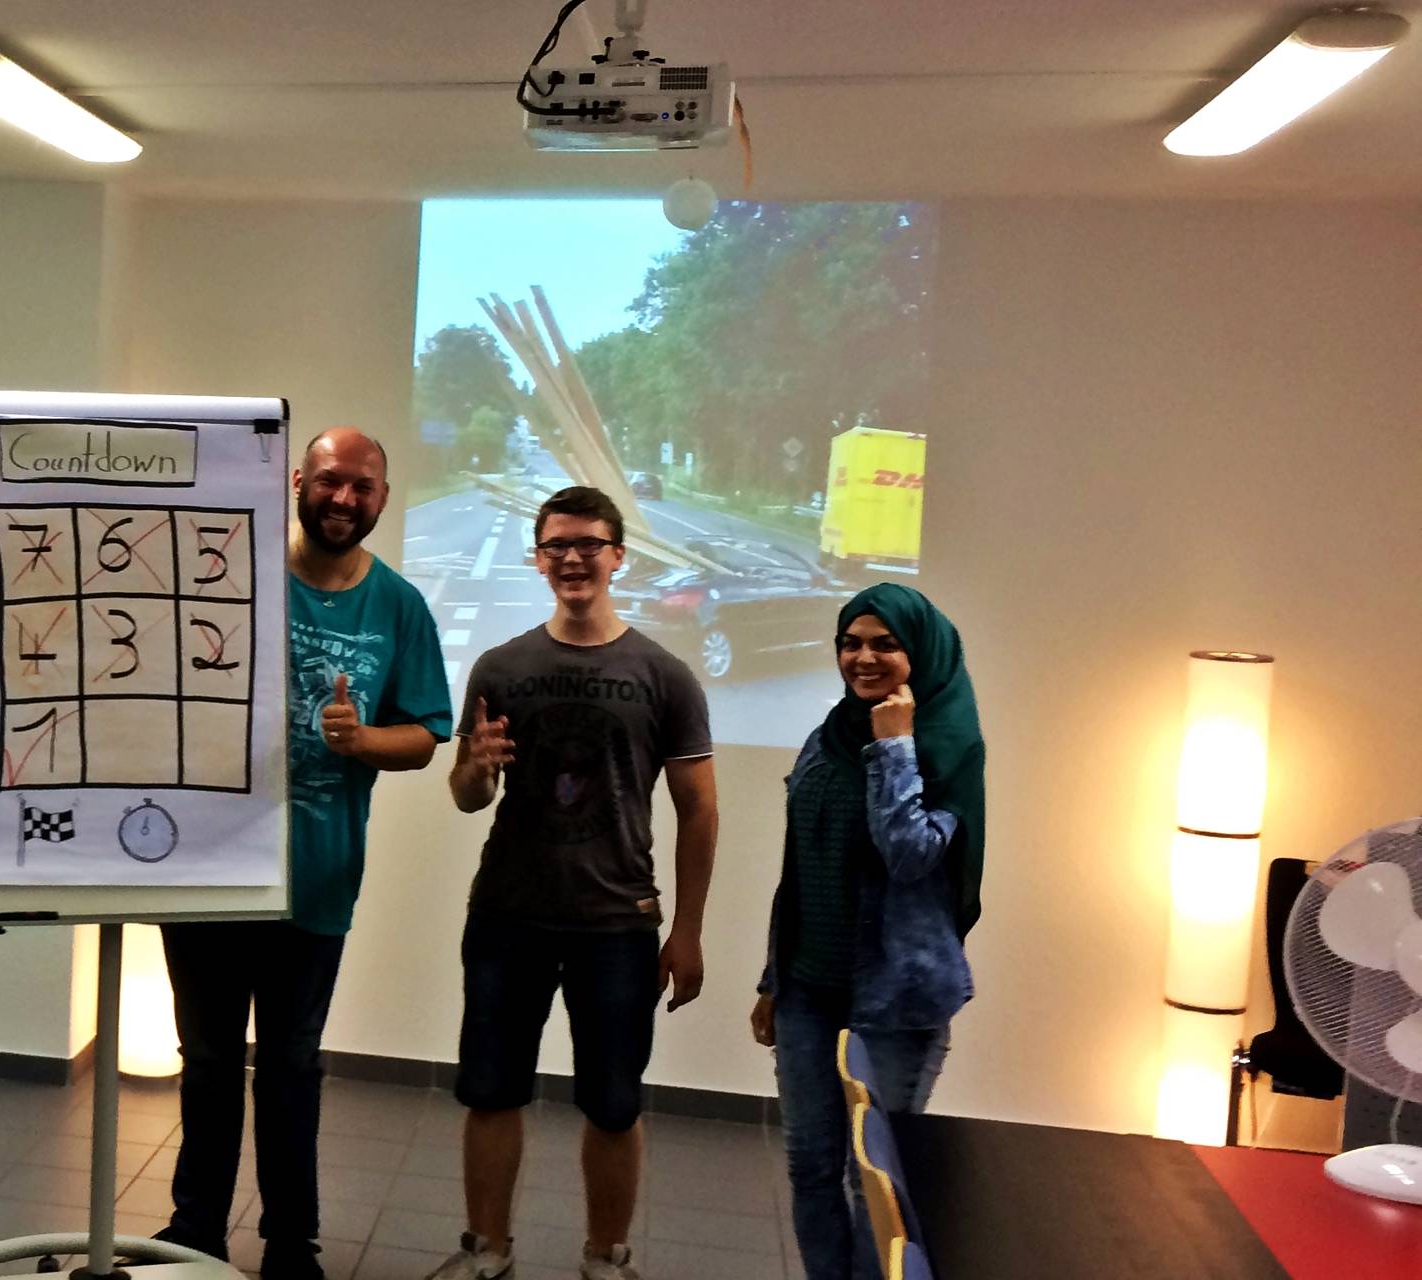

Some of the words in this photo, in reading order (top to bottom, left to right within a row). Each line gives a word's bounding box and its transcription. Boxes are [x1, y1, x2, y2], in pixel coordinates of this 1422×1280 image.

[9, 430, 177, 474] Countdown
[8, 523, 53, 572] 7
[96, 516, 134, 573] 6
[193, 526, 229, 584] 5
[18, 622, 57, 675] 4
[108, 608, 140, 679] 3
[190, 618, 240, 670] 2
[12, 706, 57, 773] 1
